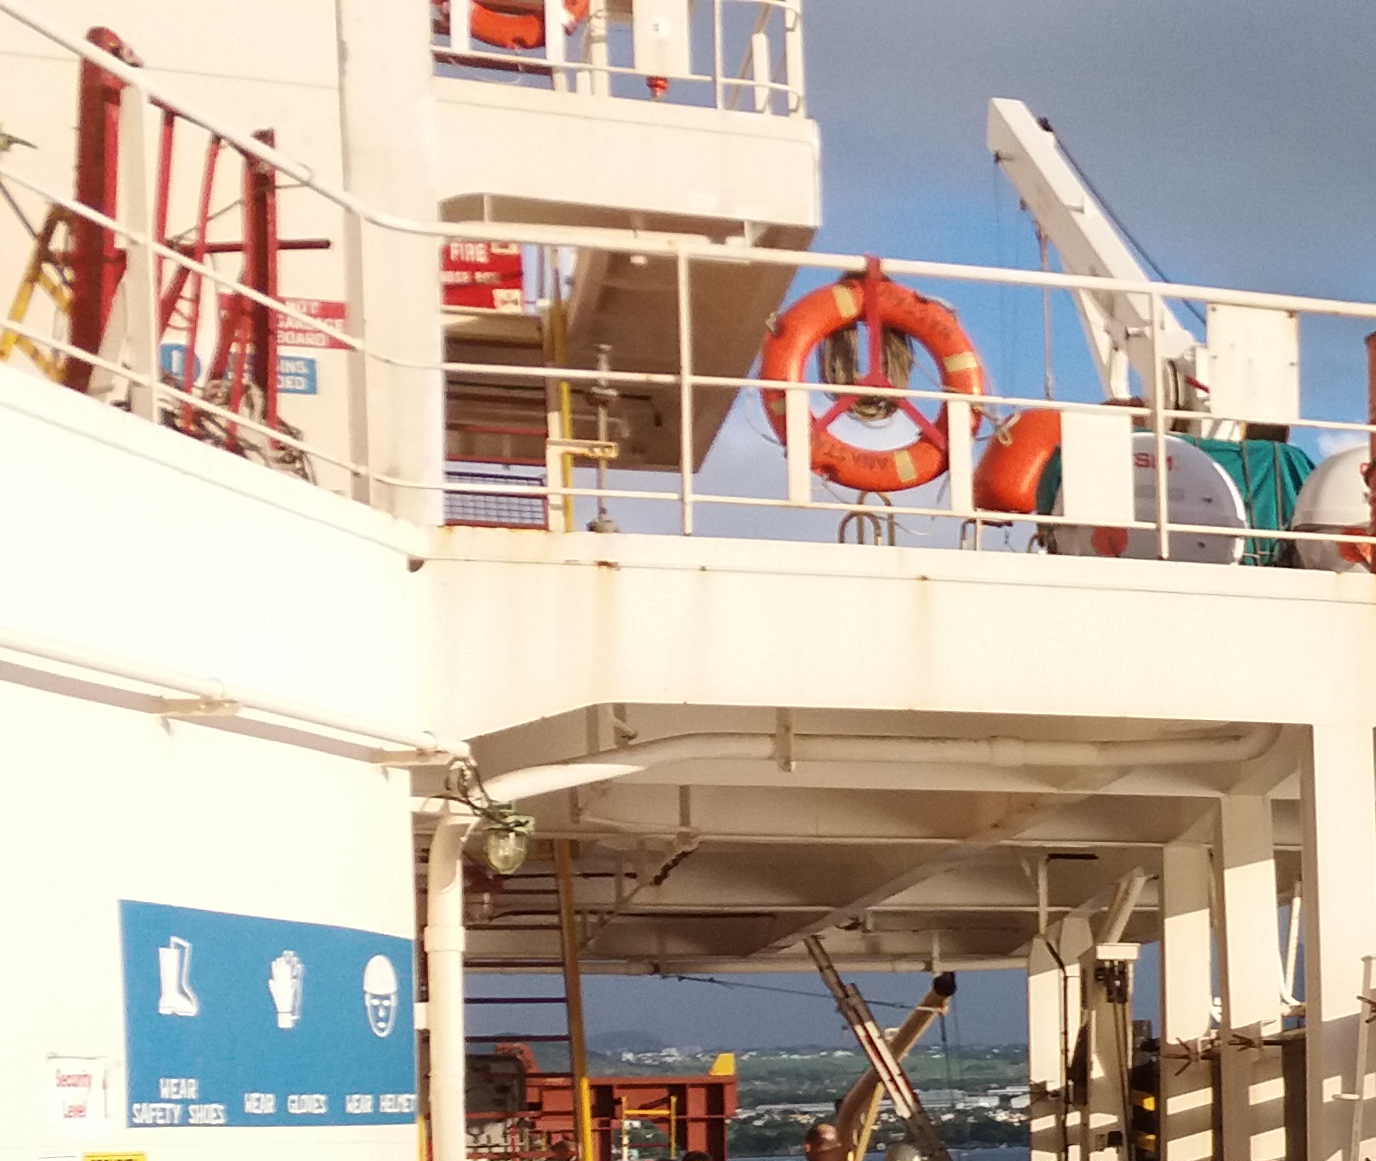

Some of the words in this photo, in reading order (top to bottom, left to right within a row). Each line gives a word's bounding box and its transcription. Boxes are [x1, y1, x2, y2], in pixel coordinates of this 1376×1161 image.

[450, 242, 486, 262] FIRE
[159, 1078, 198, 1100] WEAR
[132, 1103, 182, 1125] SAFETY
[188, 1104, 226, 1125] SHOES
[244, 1092, 276, 1114] WEAR
[287, 1094, 328, 1114] GLOVES
[345, 1094, 373, 1114] WEAR
